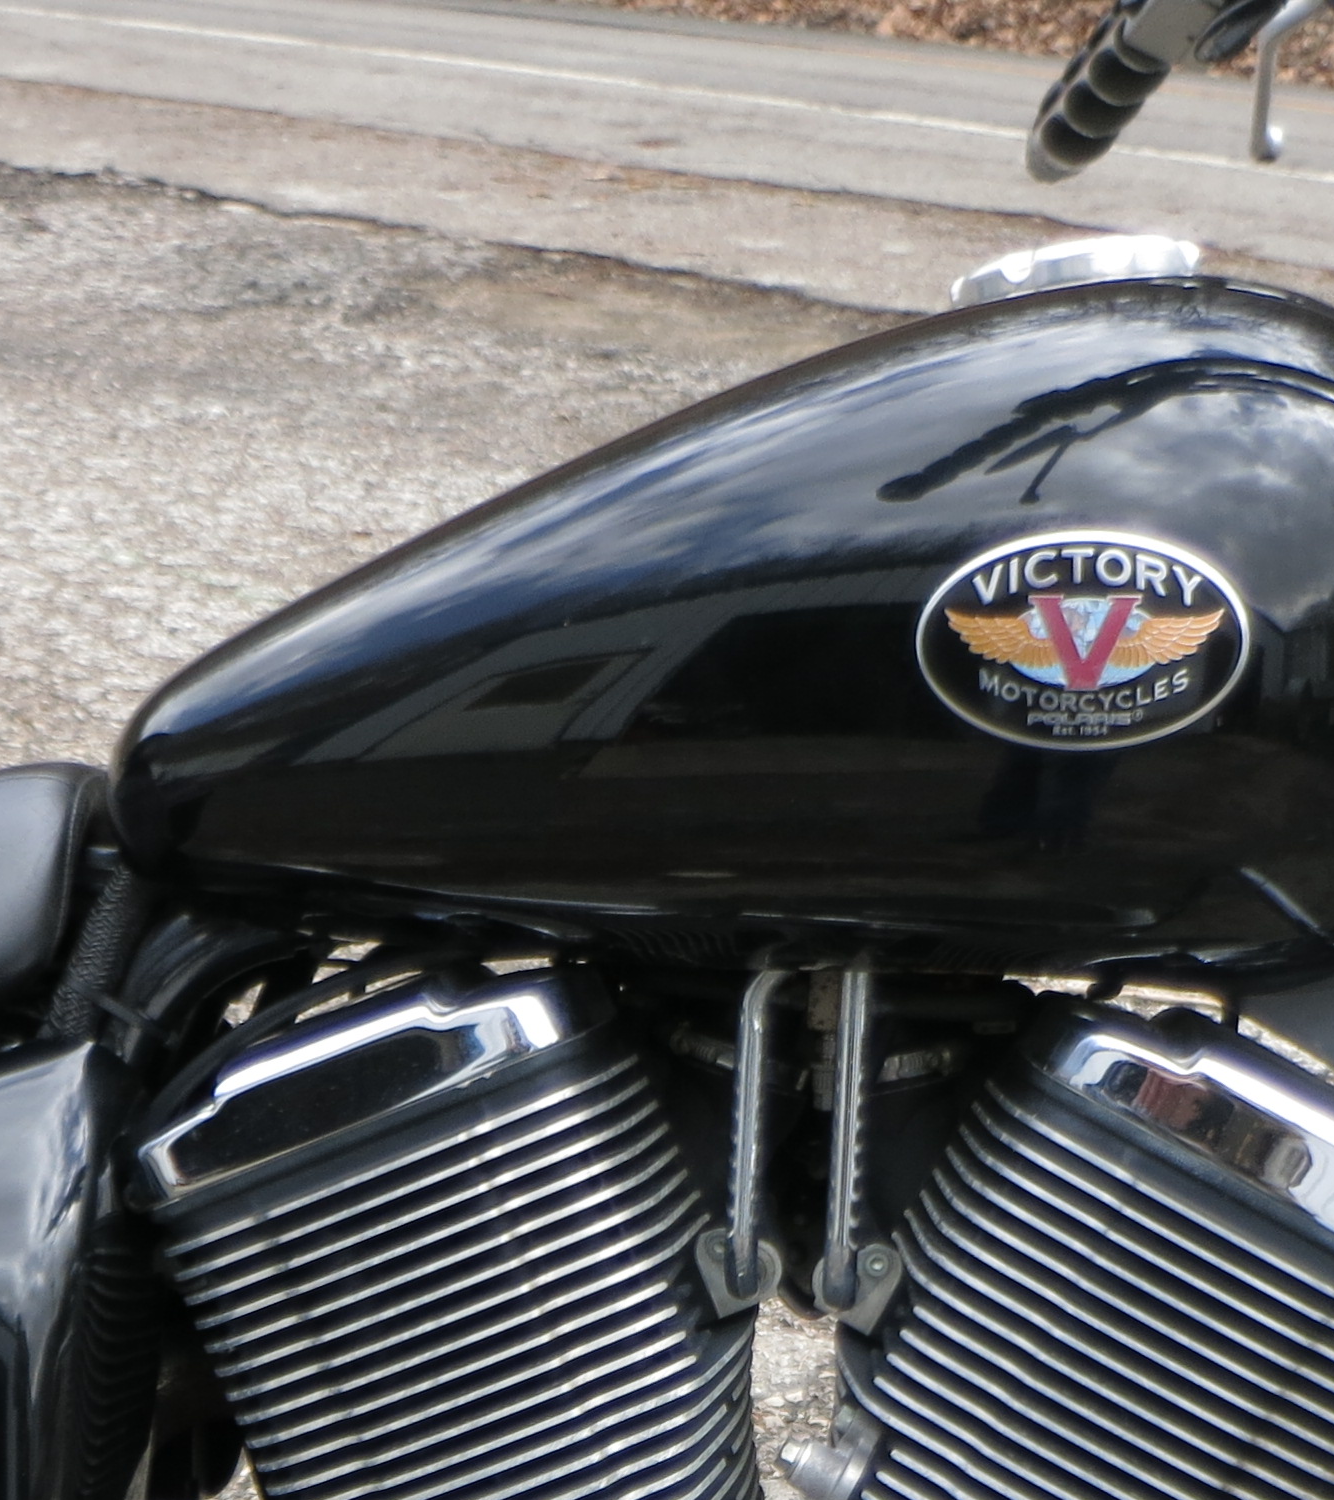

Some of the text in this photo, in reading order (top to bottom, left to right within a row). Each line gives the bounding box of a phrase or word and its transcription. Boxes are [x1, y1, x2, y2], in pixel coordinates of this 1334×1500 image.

[972, 548, 1202, 606] VICTORY
[1028, 595, 1142, 690] V
[978, 668, 1190, 712] MOTORCYCLES
